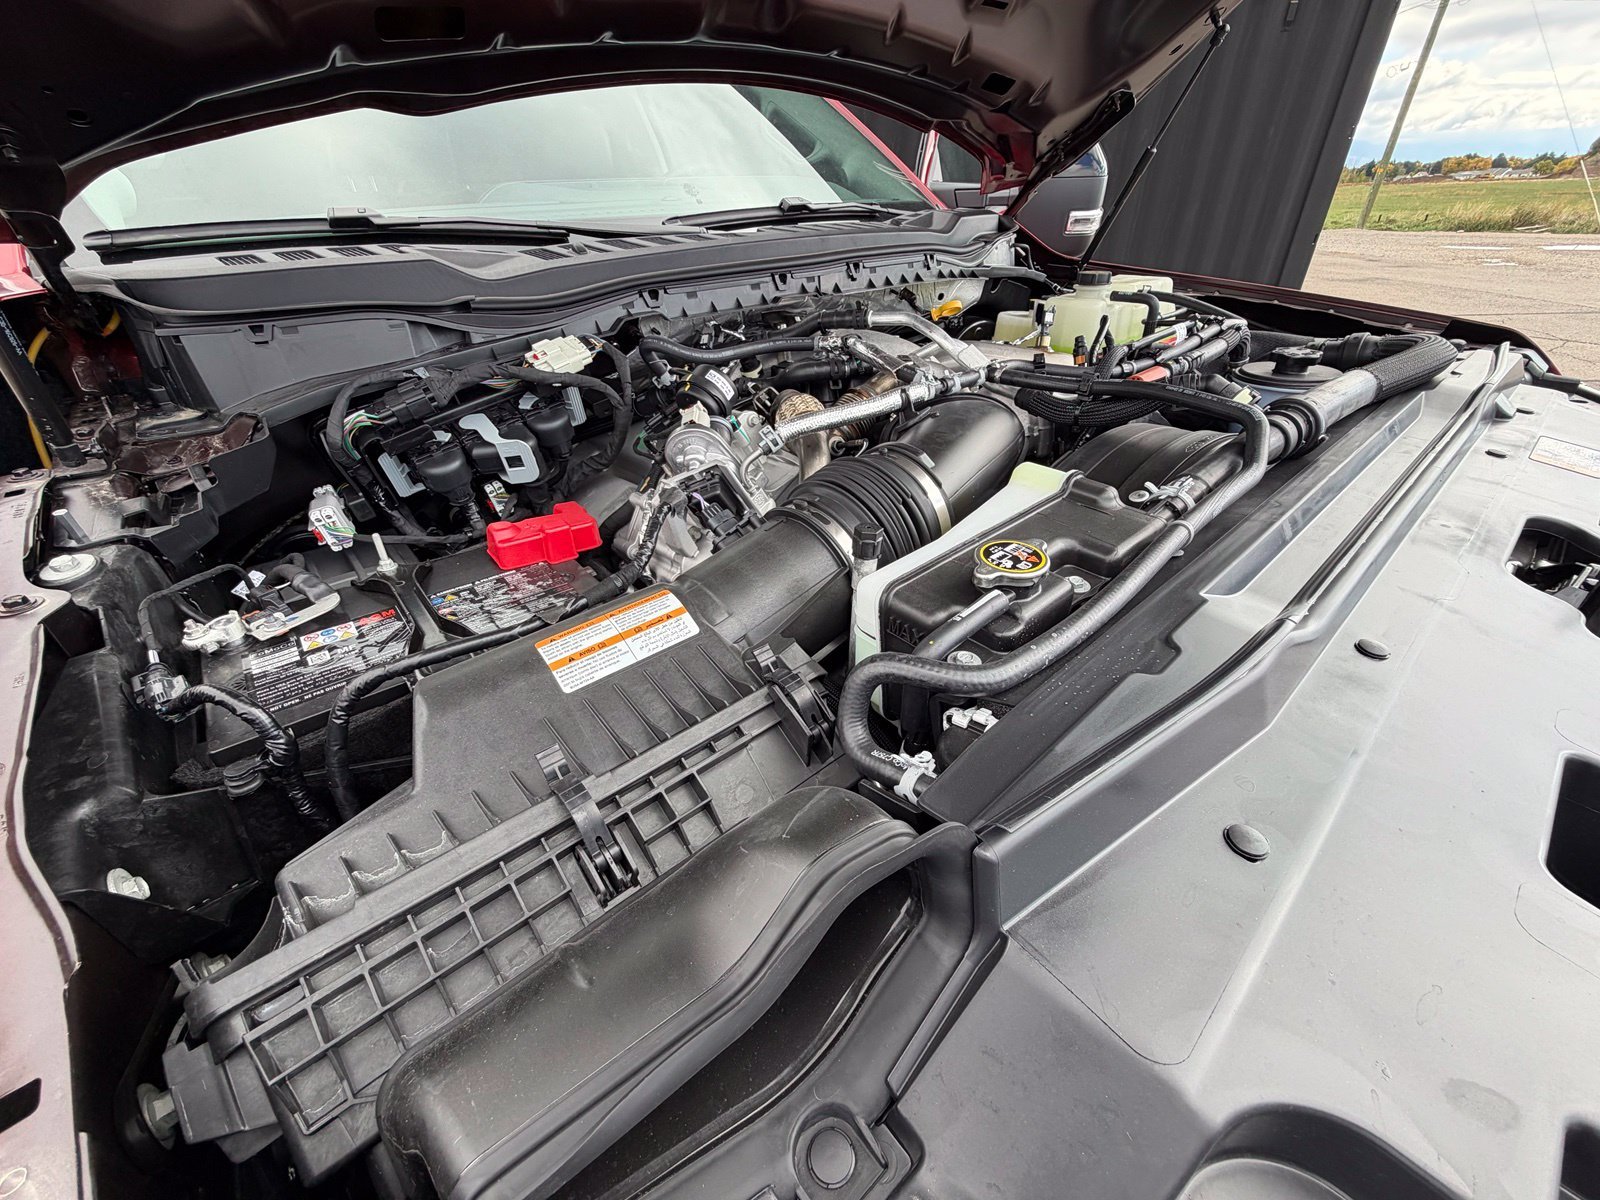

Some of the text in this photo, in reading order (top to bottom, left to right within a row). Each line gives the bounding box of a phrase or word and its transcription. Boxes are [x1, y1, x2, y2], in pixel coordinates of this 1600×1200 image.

[359, 608, 396, 625] AGM
[559, 626, 585, 639] WARNING
[578, 647, 597, 657] AVISO
